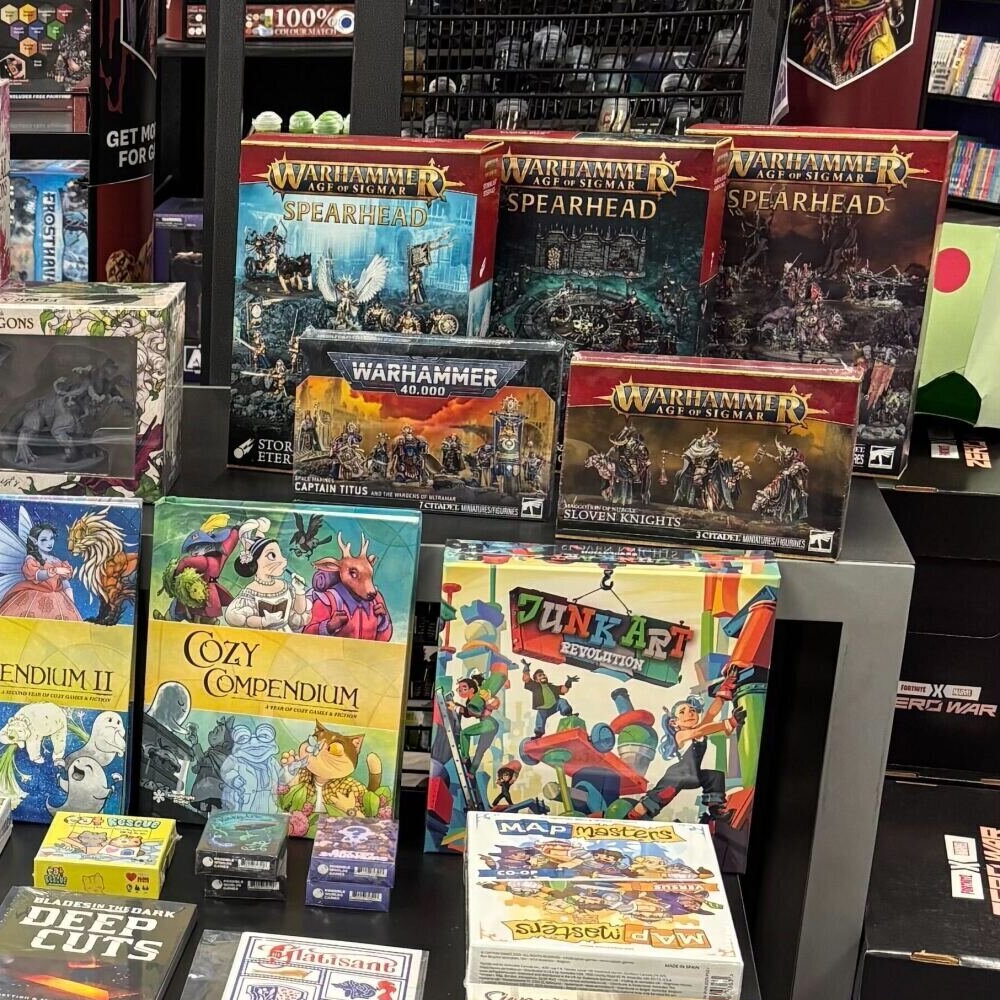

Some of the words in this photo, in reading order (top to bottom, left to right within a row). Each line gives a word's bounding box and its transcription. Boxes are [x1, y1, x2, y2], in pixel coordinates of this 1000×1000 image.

[274, 8, 335, 28] 100%
[106, 128, 138, 148] GET
[118, 149, 145, 168] FOR
[727, 150, 904, 185] WARHAMMER
[269, 161, 443, 199] WARHAMMER
[502, 157, 673, 193] WARHAMMER
[533, 177, 560, 186] AGE
[579, 178, 635, 190] SIGMAR
[756, 171, 785, 180] AGE
[805, 171, 865, 183] SIGMAR
[308, 182, 334, 192] AGE
[352, 184, 406, 196] SIGMAR
[507, 193, 658, 220] SPEARHEAD
[727, 189, 886, 215] SPEARHEAD
[283, 200, 428, 227] SPEARHEAD
[351, 361, 498, 388] WARHAMMER
[614, 383, 805, 425] WARHAMMER
[655, 406, 685, 416] AGE
[704, 408, 766, 421] SIGMAR
[258, 438, 293, 452] STOR
[257, 451, 293, 465] ETER
[294, 482, 337, 493] CAPTAIN
[339, 485, 368, 496] TITUS
[424, 502, 460, 512] CITADEL
[563, 509, 616, 522] SLOVEN
[620, 512, 682, 527] KNIGHTS
[701, 531, 742, 542] CITADEL
[183, 630, 261, 669] COZY
[560, 641, 646, 671] REVOLUTION
[93, 670, 115, 692] II
[203, 667, 359, 710] COMPENDIUM
[945, 701, 998, 717] WAR
[499, 821, 568, 838] MAP
[496, 868, 539, 877] CO-OP
[33, 896, 92, 909] BLADES
[109, 904, 131, 913] THE
[130, 907, 176, 919] DARK
[19, 905, 158, 938] DEEP
[30, 929, 164, 961] CUTS
[631, 928, 711, 948] MAP
